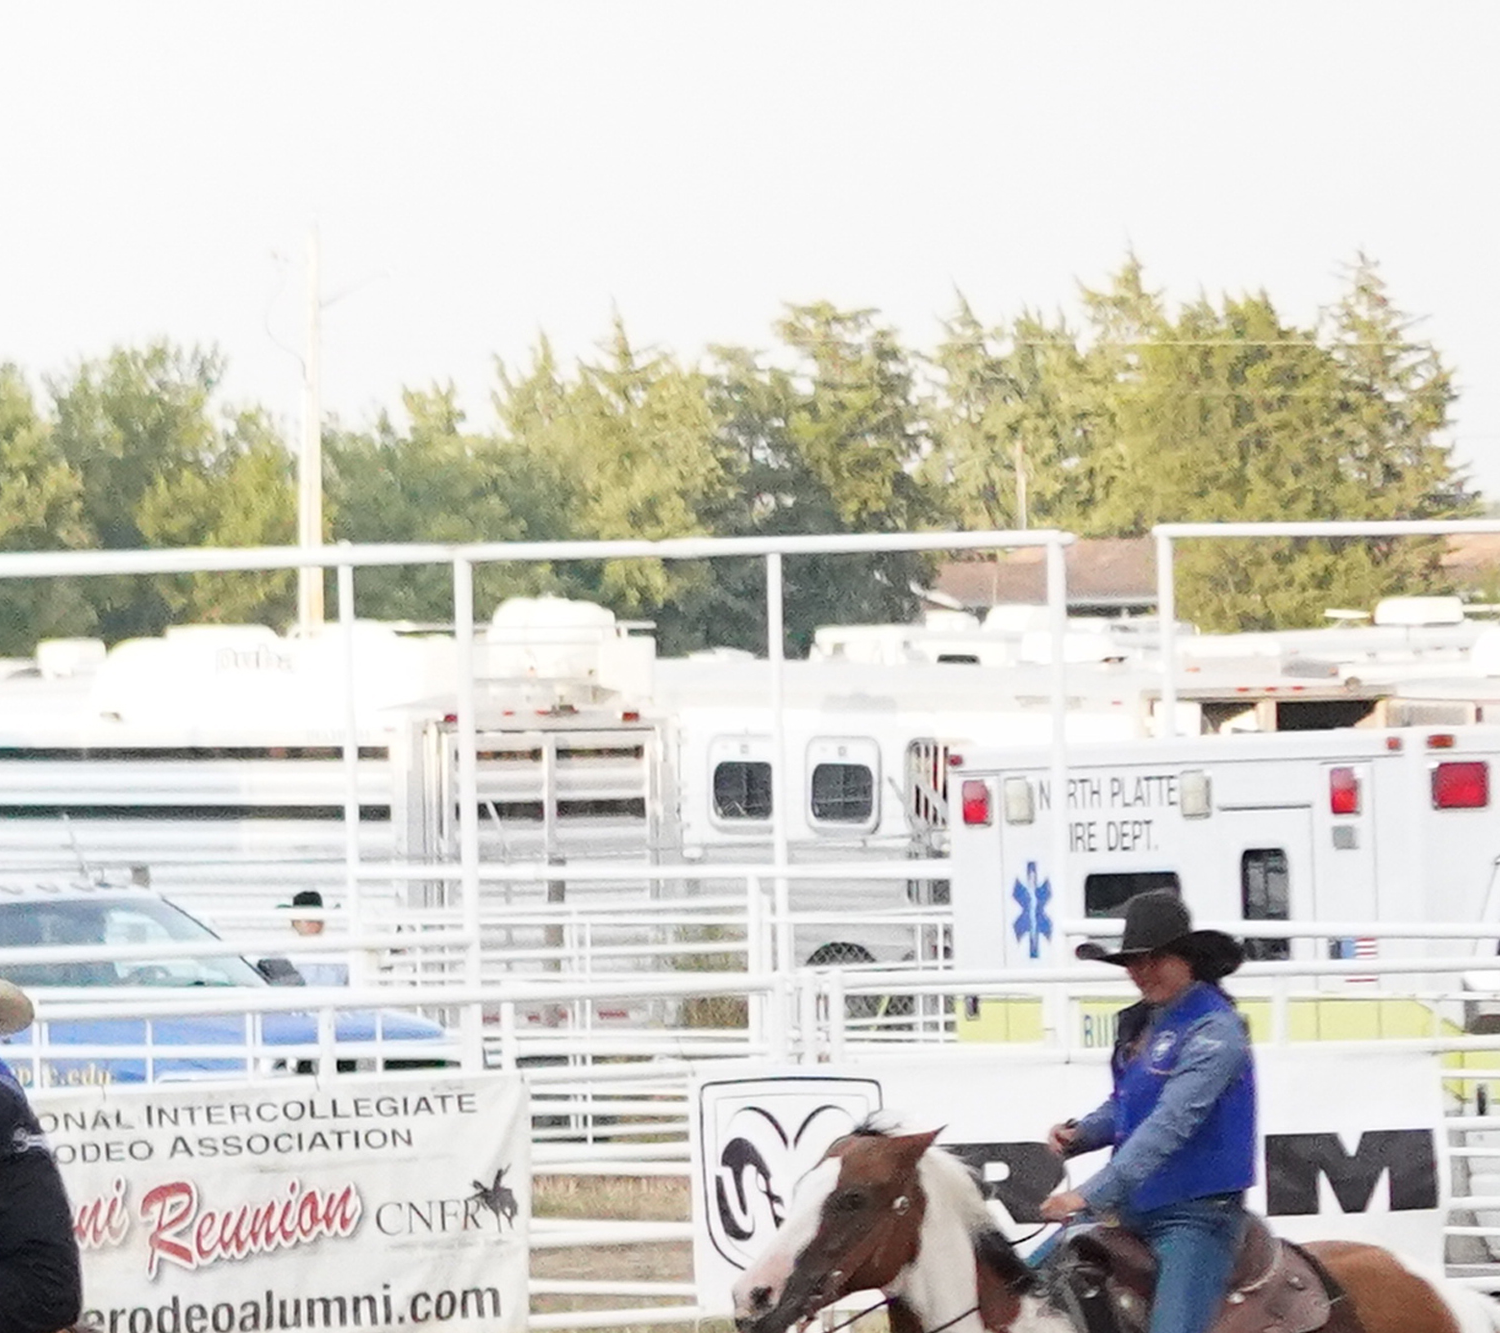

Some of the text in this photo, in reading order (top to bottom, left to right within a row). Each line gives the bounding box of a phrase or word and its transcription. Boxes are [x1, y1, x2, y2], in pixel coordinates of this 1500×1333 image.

[1039, 775, 1178, 811] NRTH PLATTE
[1069, 820, 1159, 852] IRE DEPT.
[40, 1093, 478, 1134] ONAL INTERCOLLEGIATE
[54, 1129, 413, 1166] ODEO ASSOCIATION
[140, 1180, 359, 1274] Reunion
[375, 1200, 484, 1236] CNFR
